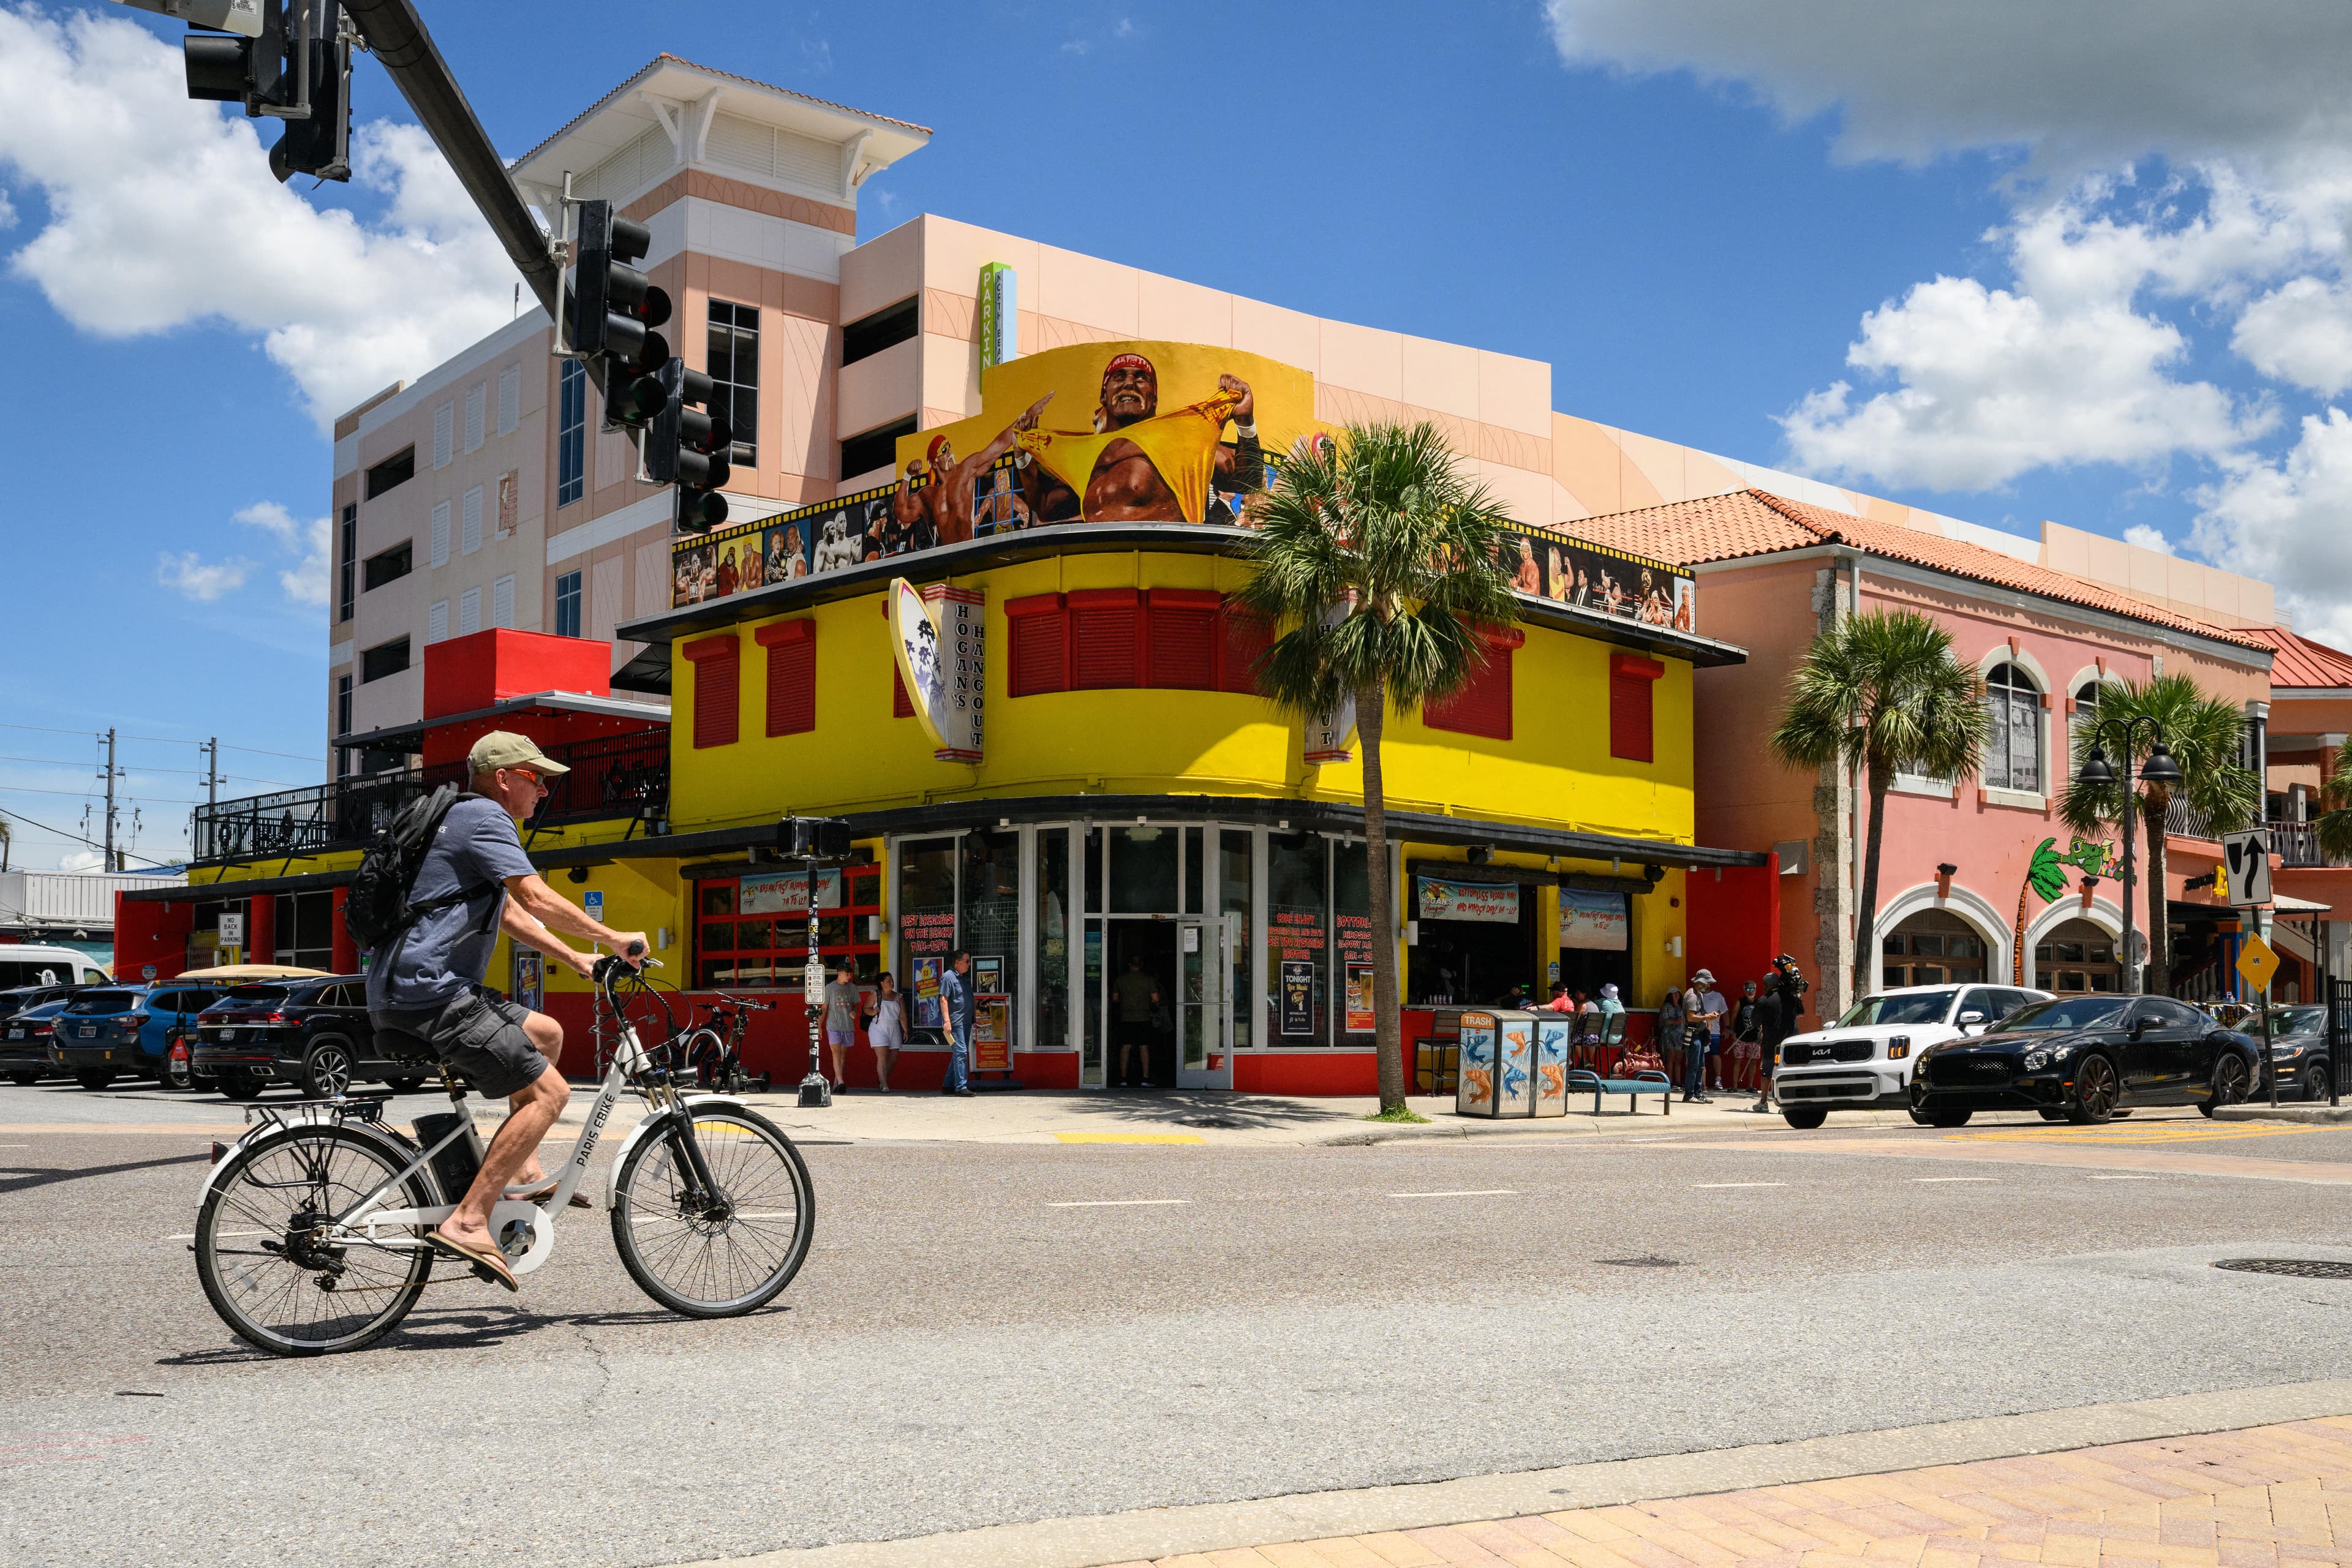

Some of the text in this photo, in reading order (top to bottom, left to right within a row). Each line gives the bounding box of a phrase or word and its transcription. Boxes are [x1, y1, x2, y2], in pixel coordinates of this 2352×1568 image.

[982, 272, 991, 370] PARKIN
[952, 603, 970, 709] HOGAN'S
[971, 624, 986, 746] HANGOUT
[760, 878, 794, 895] BREAKFAST
[790, 880, 809, 892] AVAILAB
[790, 894, 799, 905] TO
[1458, 887, 1488, 902] BOTTOMLESS
[1490, 891, 1506, 902] BLOODY
[1421, 896, 1453, 906] HOGAN'S
[1457, 902, 1467, 912] AND
[901, 913, 955, 927] BEST BREAKFAST
[1276, 913, 1315, 925] COME ENJOY
[1336, 914, 1371, 928] BOTTOML
[904, 927, 954, 939] ON THE BEACH!
[1300, 927, 1310, 937] AND
[1343, 930, 1371, 940] MIMOSAS
[1267, 936, 1324, 949] SEE YOU UPSTAIRS
[1337, 939, 1373, 950] BLOODY MA
[1282, 948, 1310, 960] BROTHER
[1285, 974, 1311, 983] TONIGHT
[1464, 1016, 1491, 1026] TRASH
[576, 1093, 616, 1167] PARIS EBIKE
